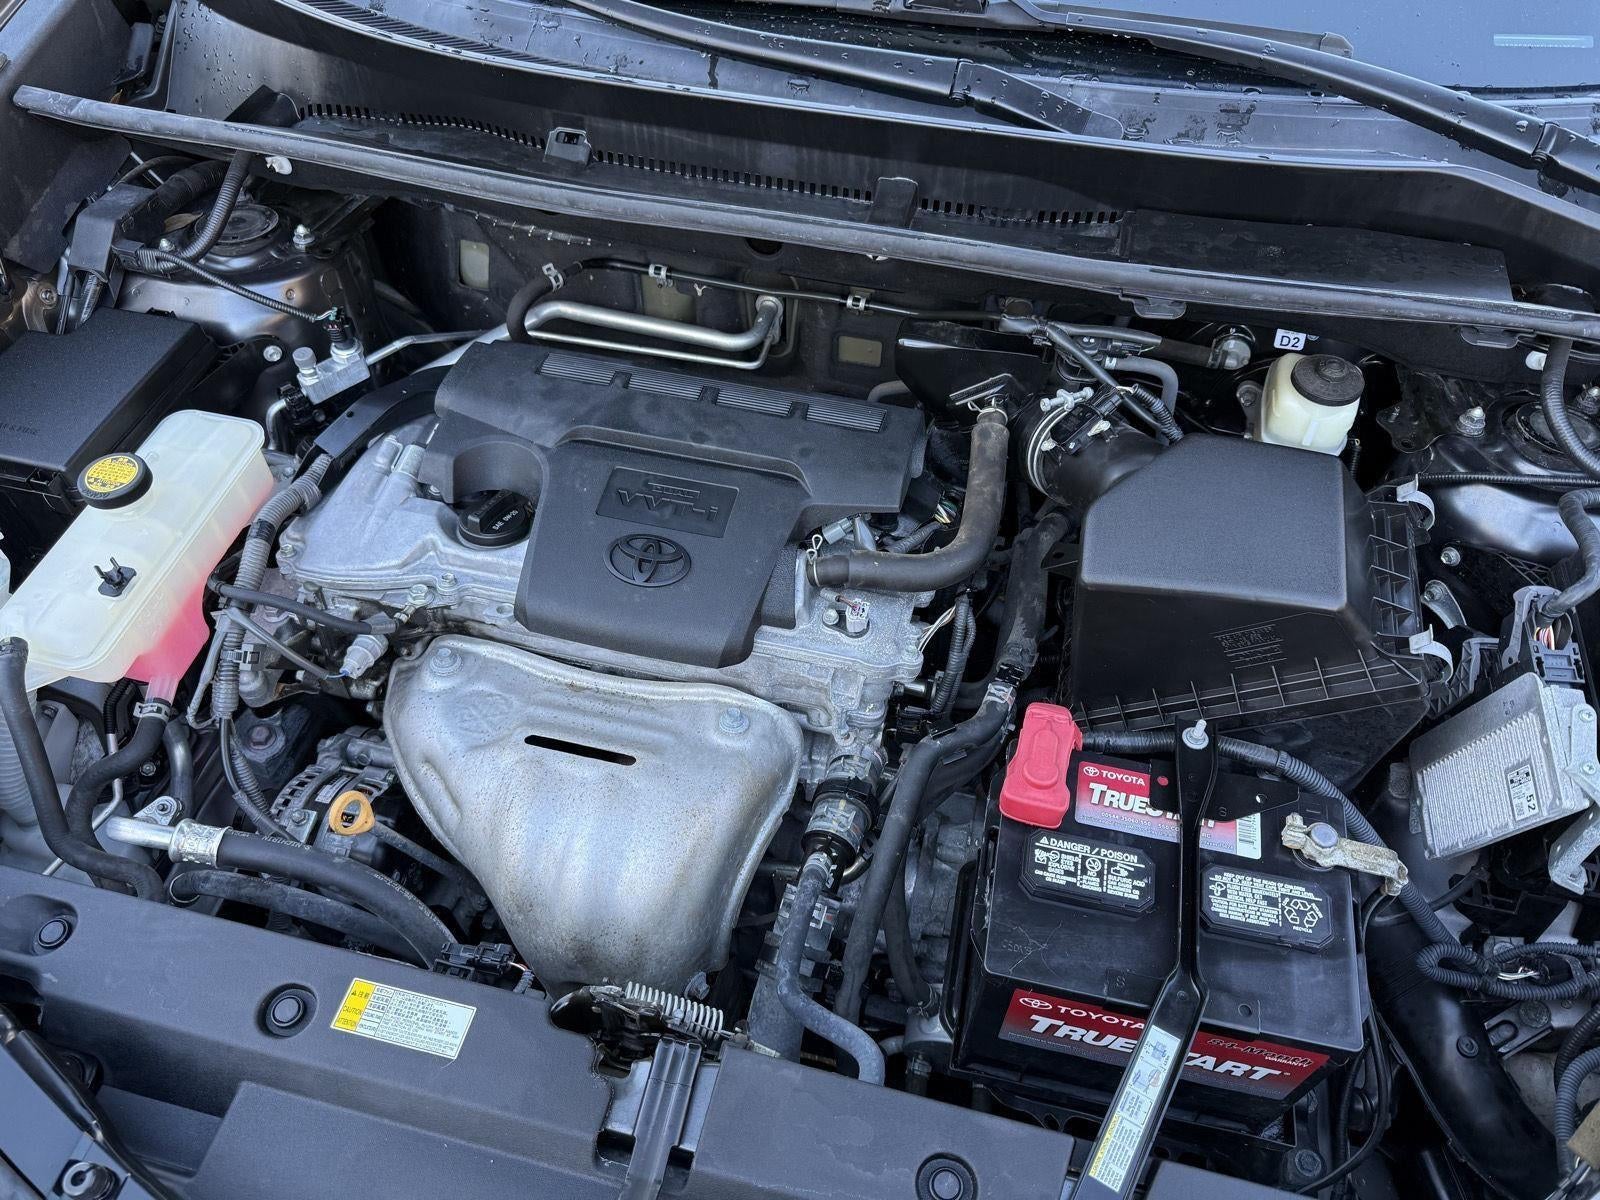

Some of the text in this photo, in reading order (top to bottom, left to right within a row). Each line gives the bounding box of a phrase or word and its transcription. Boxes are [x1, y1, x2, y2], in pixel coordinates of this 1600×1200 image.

[1279, 335, 1300, 348] D2
[1101, 770, 1146, 786] TOYOTA
[1526, 793, 1536, 812] 52
[1050, 838, 1090, 854] DANGER
[1101, 849, 1138, 863] POISON
[343, 1005, 362, 1015] CAUTION
[1057, 1005, 1145, 1029] TOYOTA
[1030, 1014, 1282, 1080] TRUEART
[1265, 1056, 1310, 1068] WARRANTY
